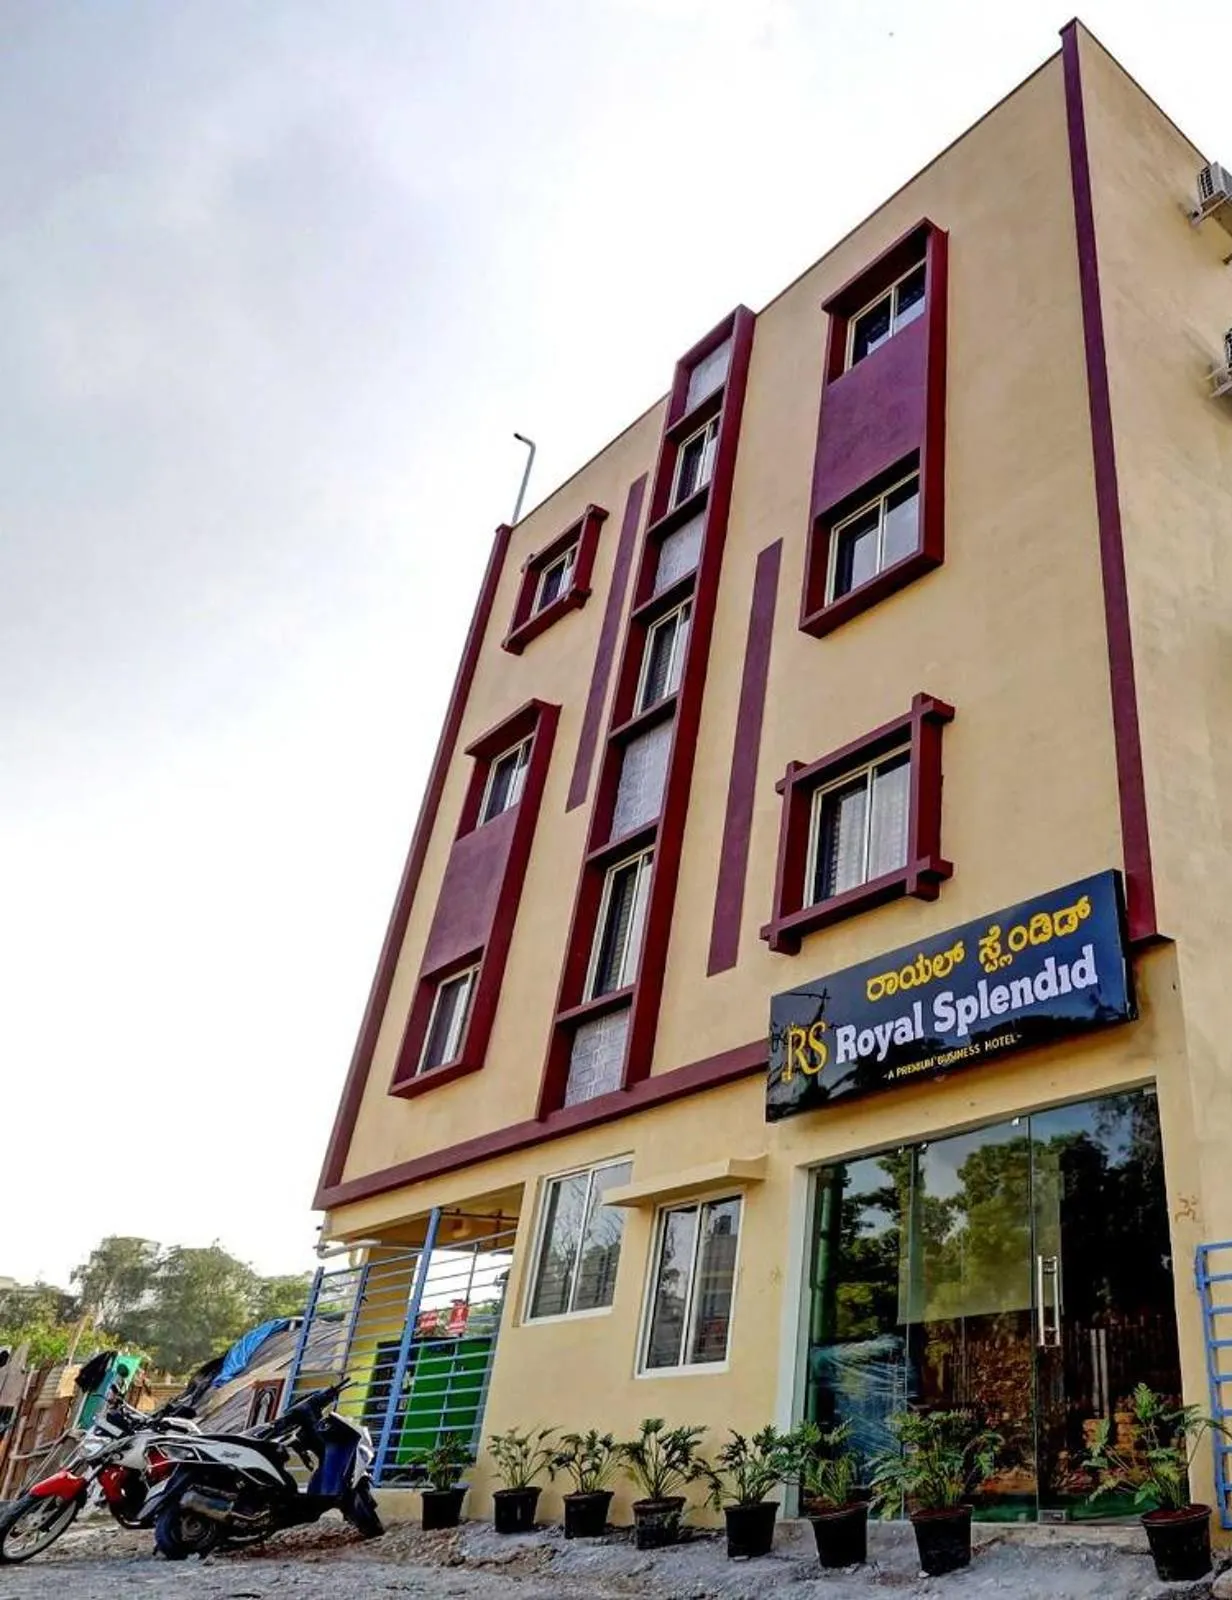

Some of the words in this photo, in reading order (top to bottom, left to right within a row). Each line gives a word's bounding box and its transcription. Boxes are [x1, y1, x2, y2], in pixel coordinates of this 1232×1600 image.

[866, 940, 966, 1002] ರಾಯಲ್
[835, 1001, 924, 1064] Royal
[933, 944, 1098, 1037] Splendid
[780, 1021, 830, 1083] RS
